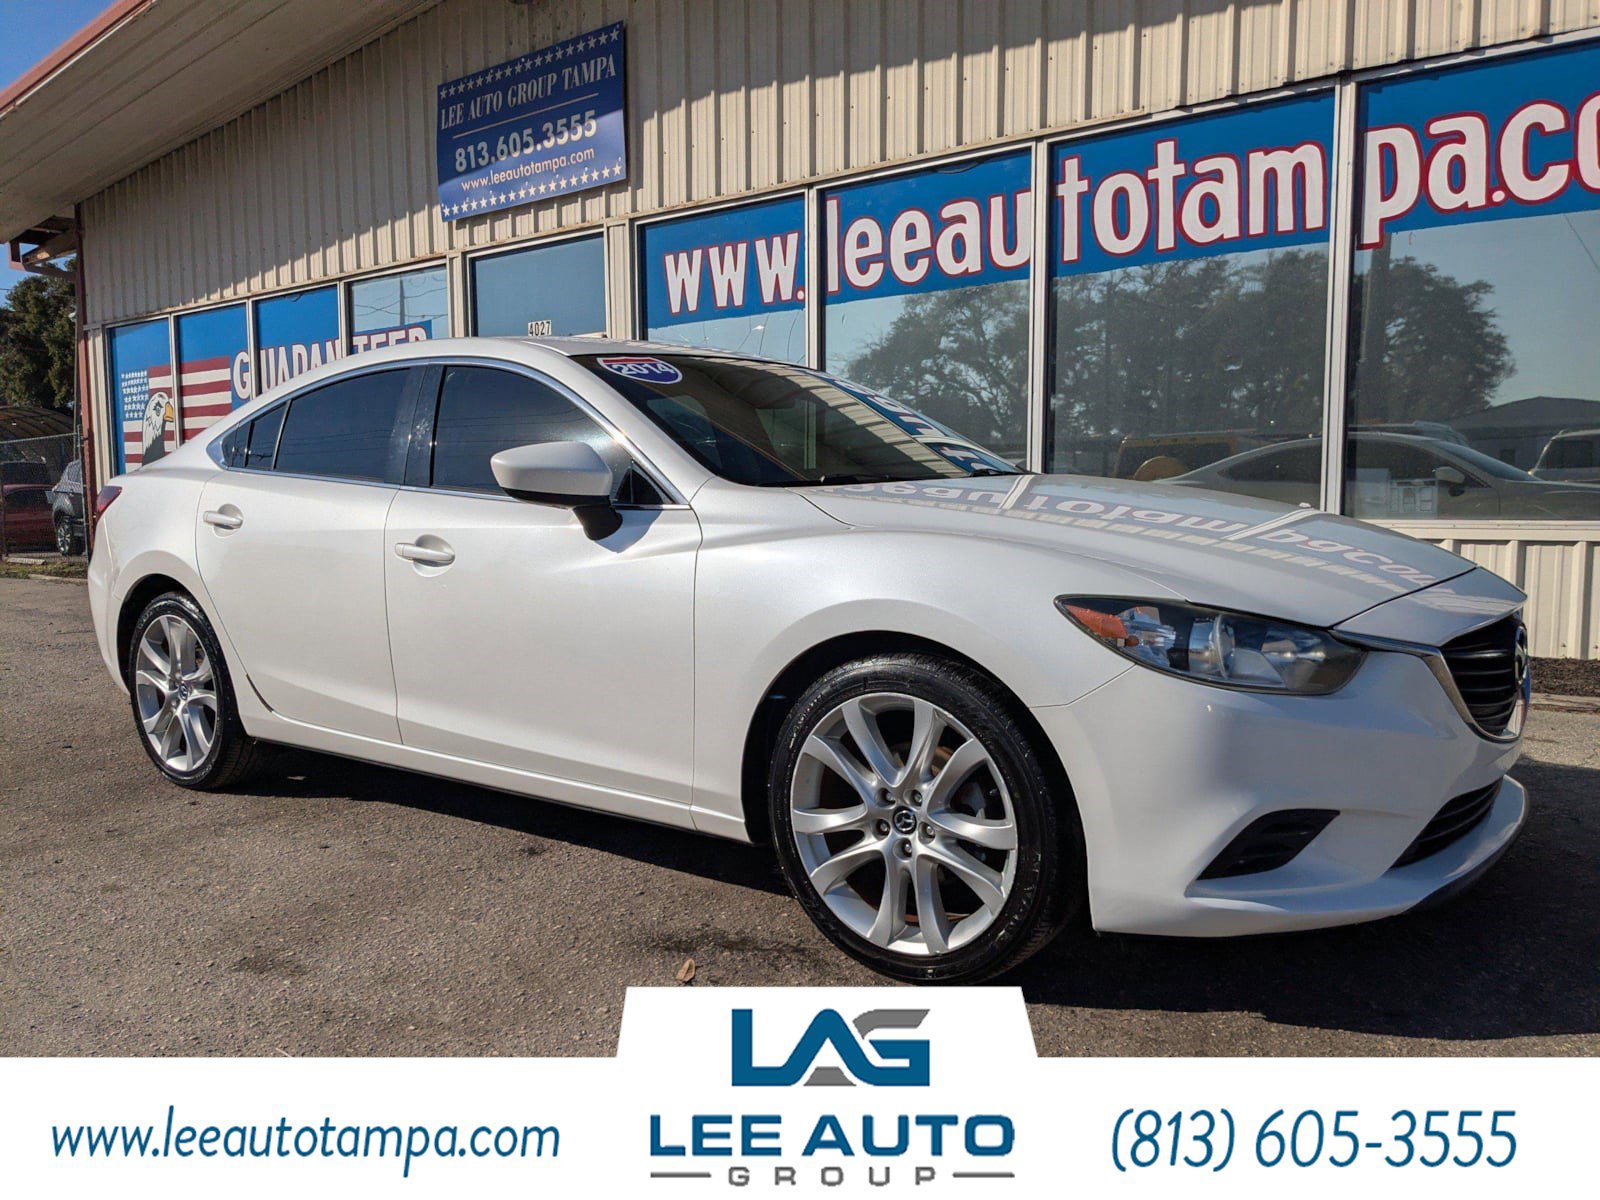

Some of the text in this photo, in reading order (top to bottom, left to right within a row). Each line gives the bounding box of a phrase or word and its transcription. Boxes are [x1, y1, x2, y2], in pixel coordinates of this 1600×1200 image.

[441, 54, 616, 130] LEE AUTO GROUP TAMPA
[455, 110, 597, 172] 813.605.3555
[461, 148, 595, 192] www.leeautotampa.com
[529, 320, 551, 336] 4027
[610, 362, 674, 376] 2014
